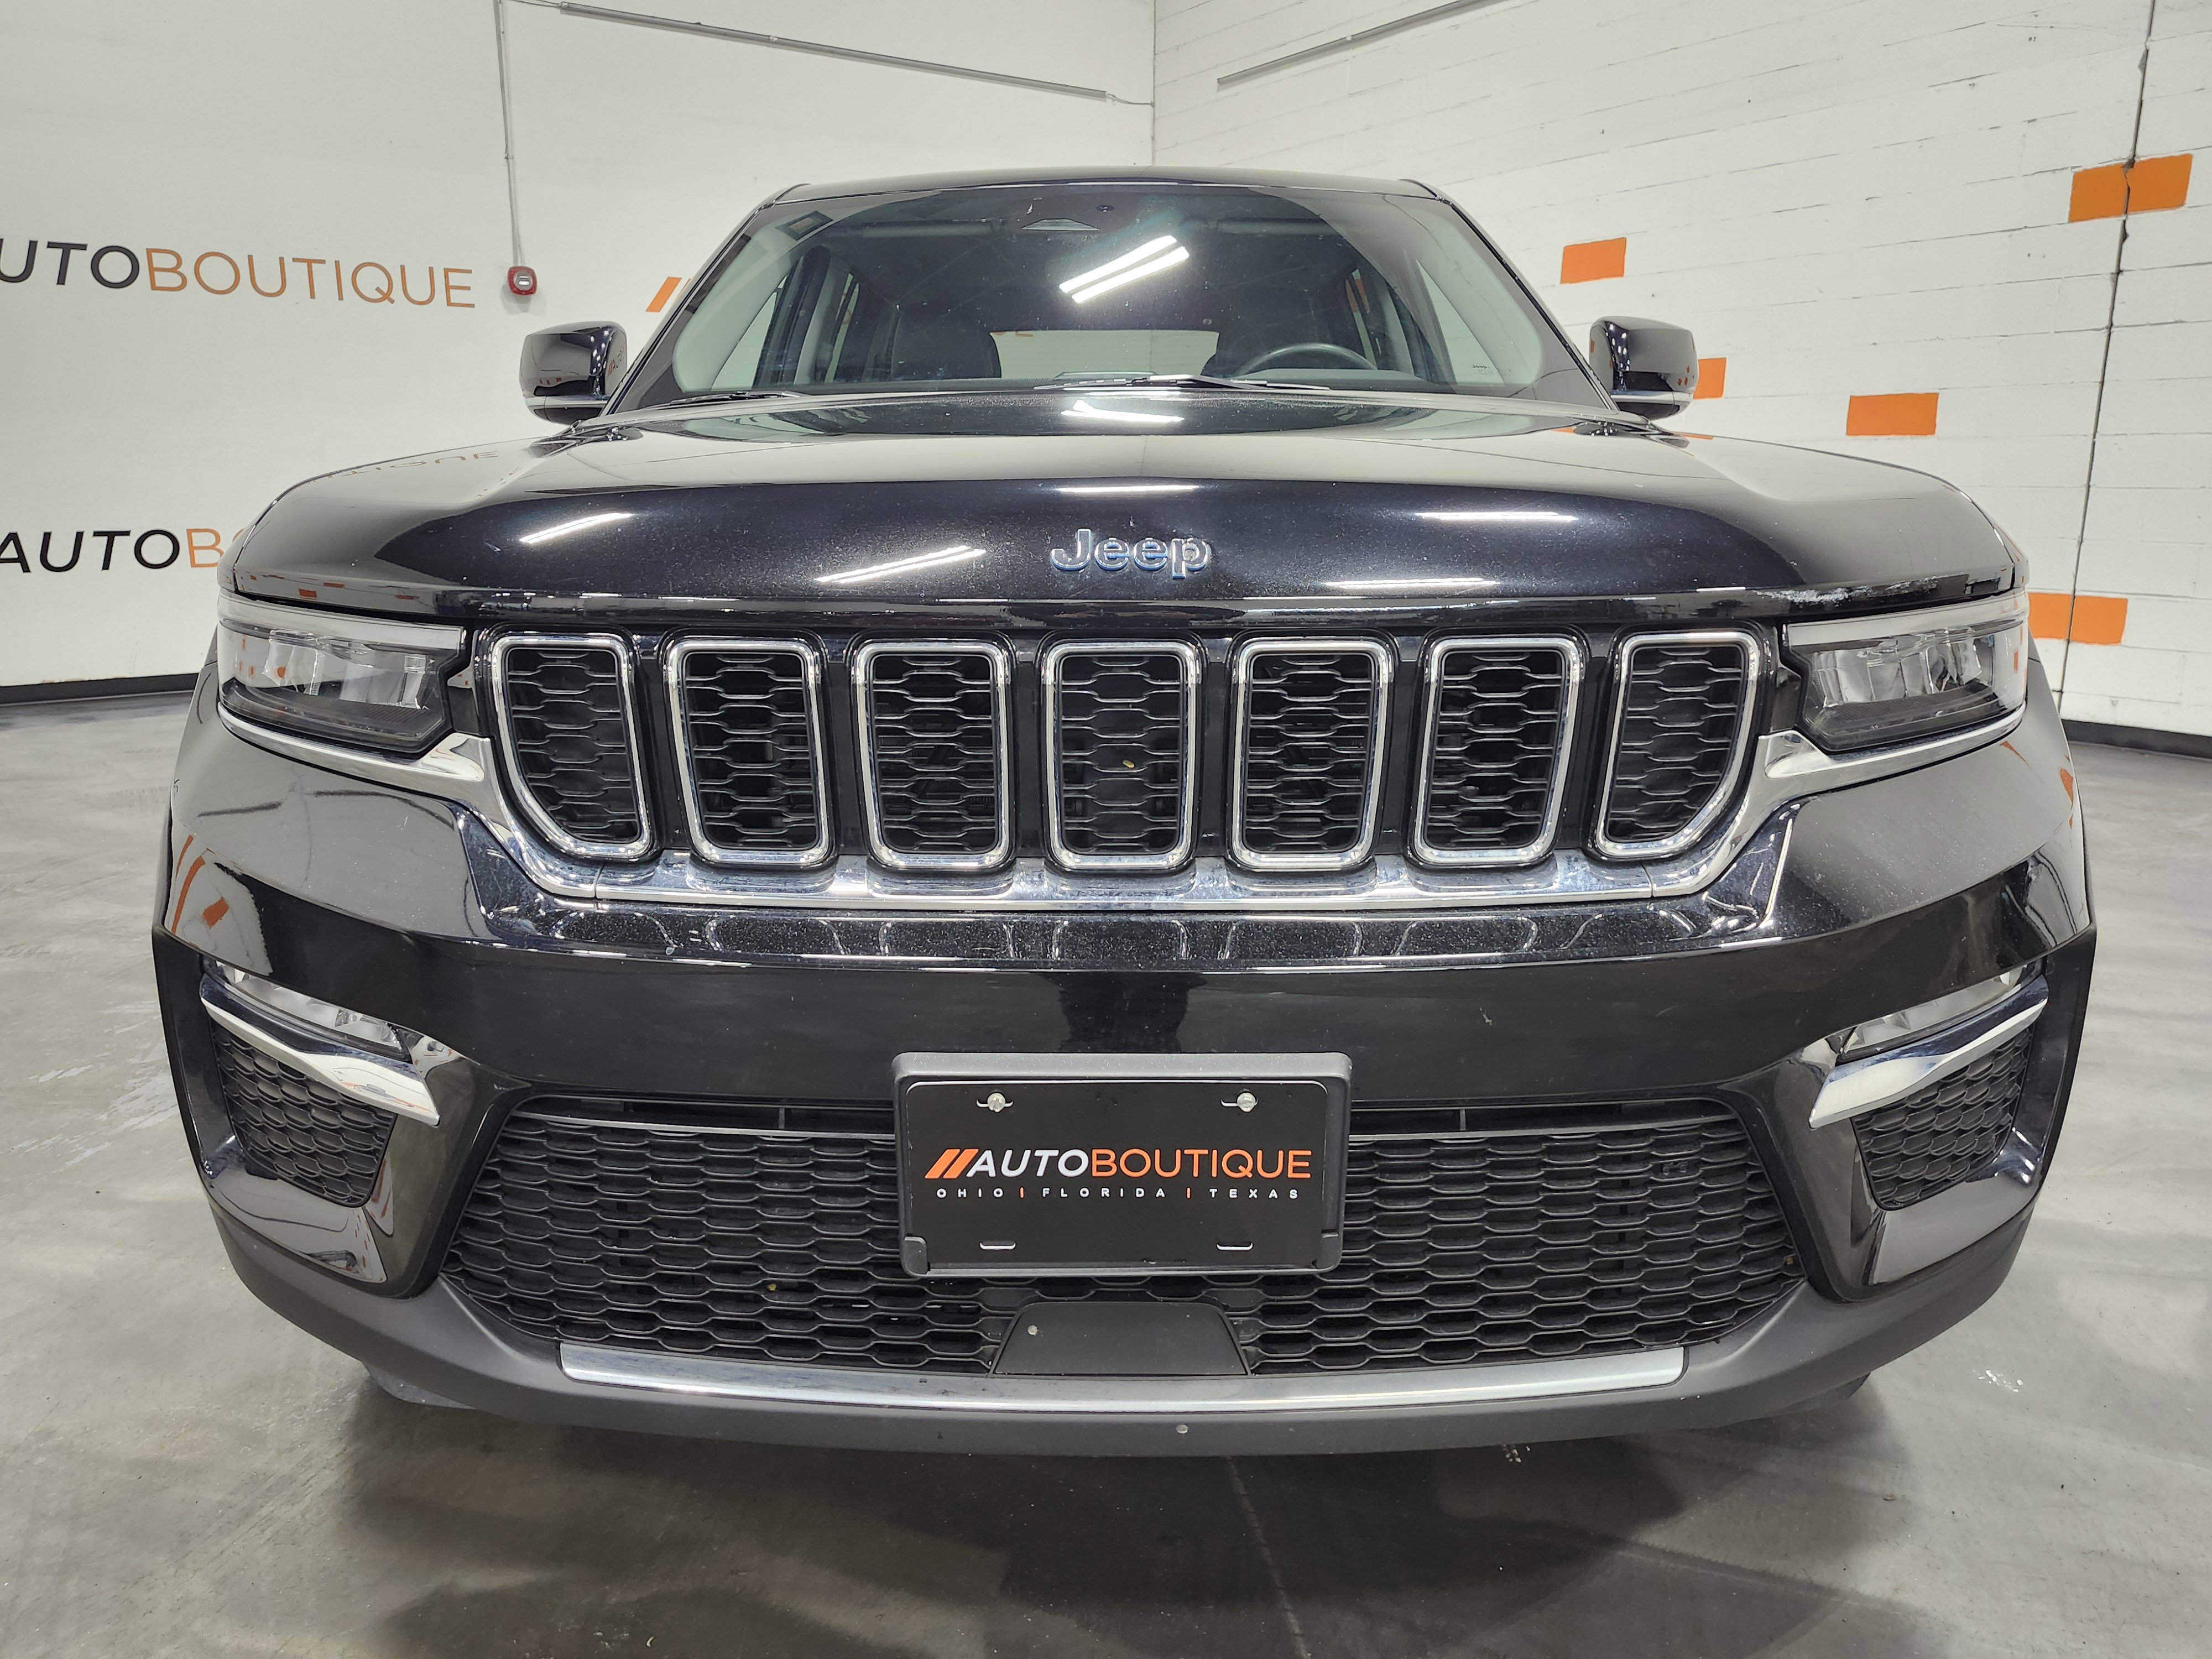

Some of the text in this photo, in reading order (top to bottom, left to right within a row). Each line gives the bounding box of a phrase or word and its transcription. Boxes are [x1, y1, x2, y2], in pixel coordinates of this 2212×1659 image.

[0, 528, 246, 573] AUTOB
[1051, 528, 1209, 579] Jeep
[966, 1149, 1312, 1178] AUTOBOUTIQUE
[936, 1187, 1298, 1199] OHIO FLORIDA TEXAS
